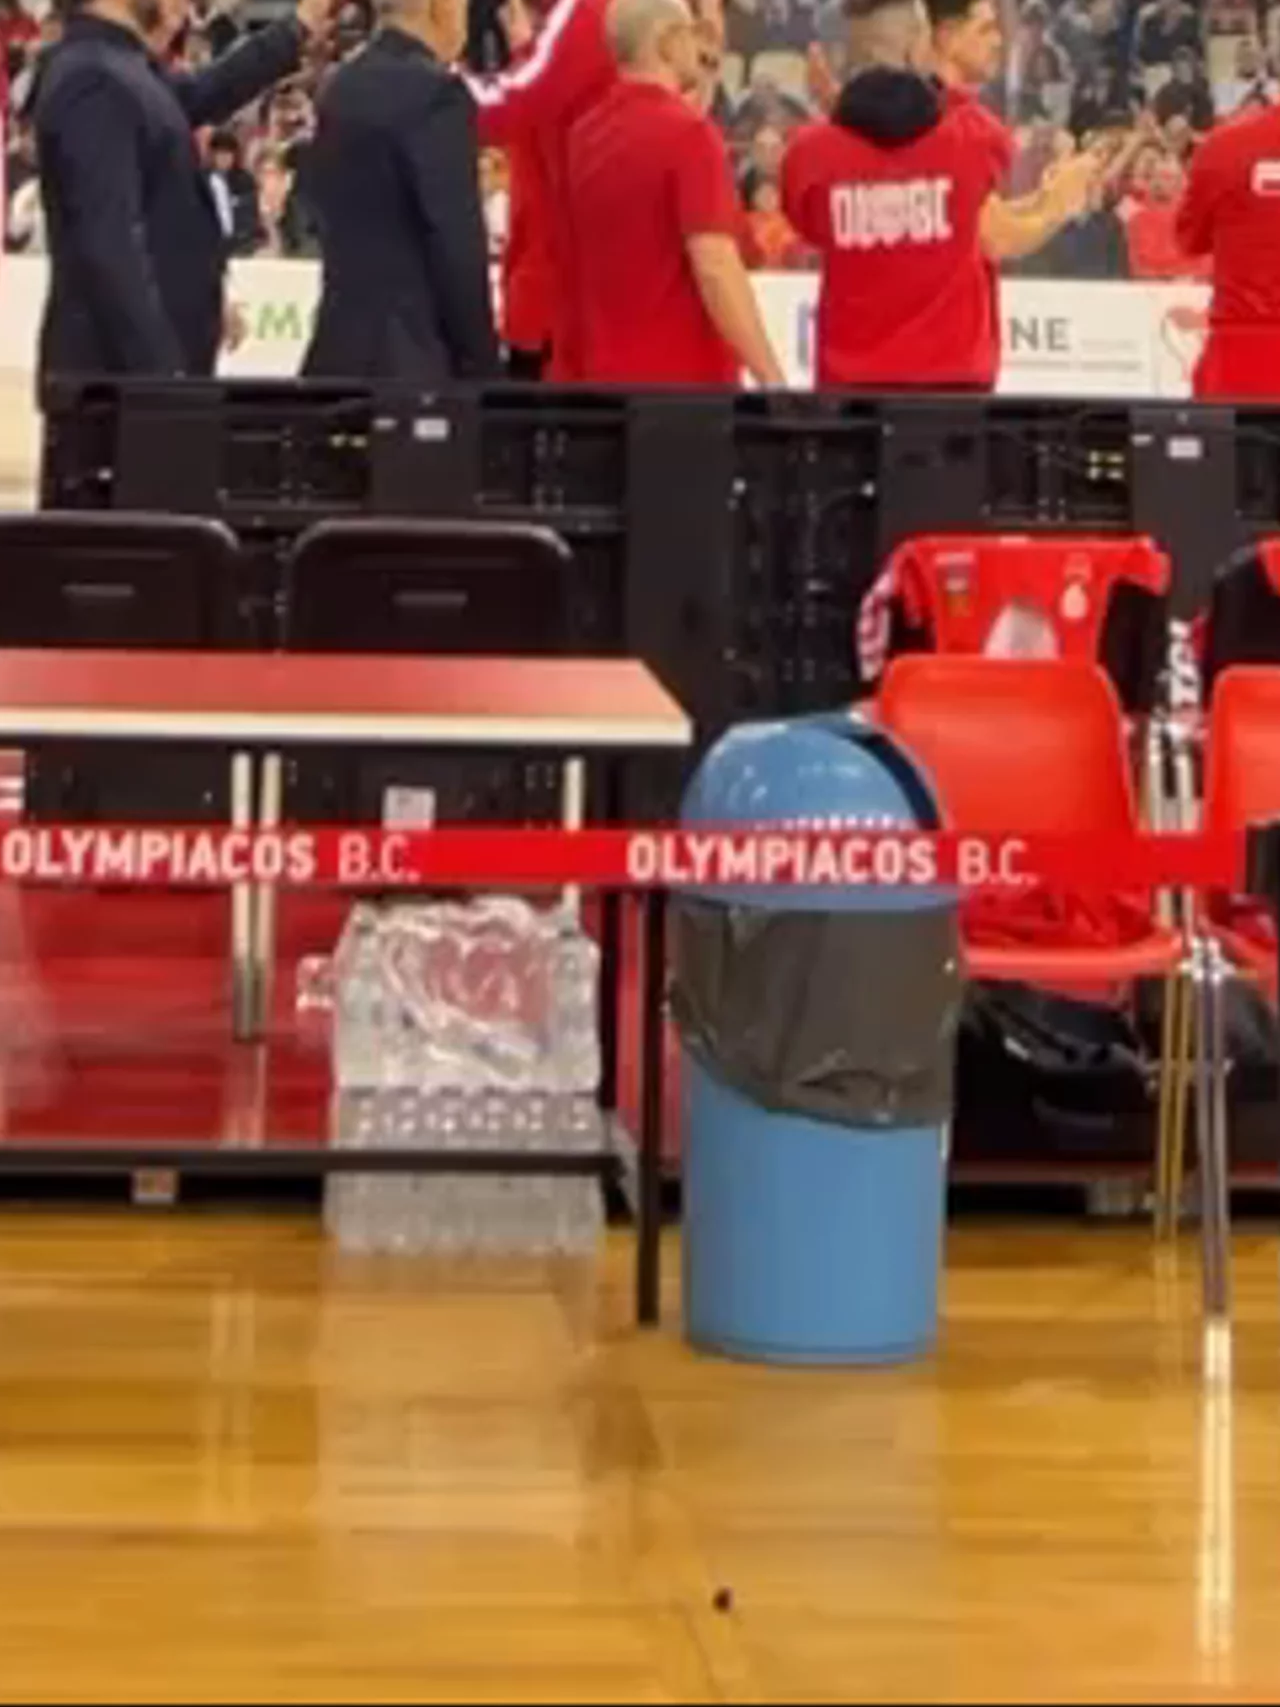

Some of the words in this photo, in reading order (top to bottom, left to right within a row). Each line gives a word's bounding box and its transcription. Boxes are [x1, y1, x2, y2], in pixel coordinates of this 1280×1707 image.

[0, 828, 316, 881] OLYMPIACOS
[336, 831, 420, 883] B.C.
[626, 832, 937, 883] OLYMPIACOS
[956, 837, 1040, 886] B.C.
